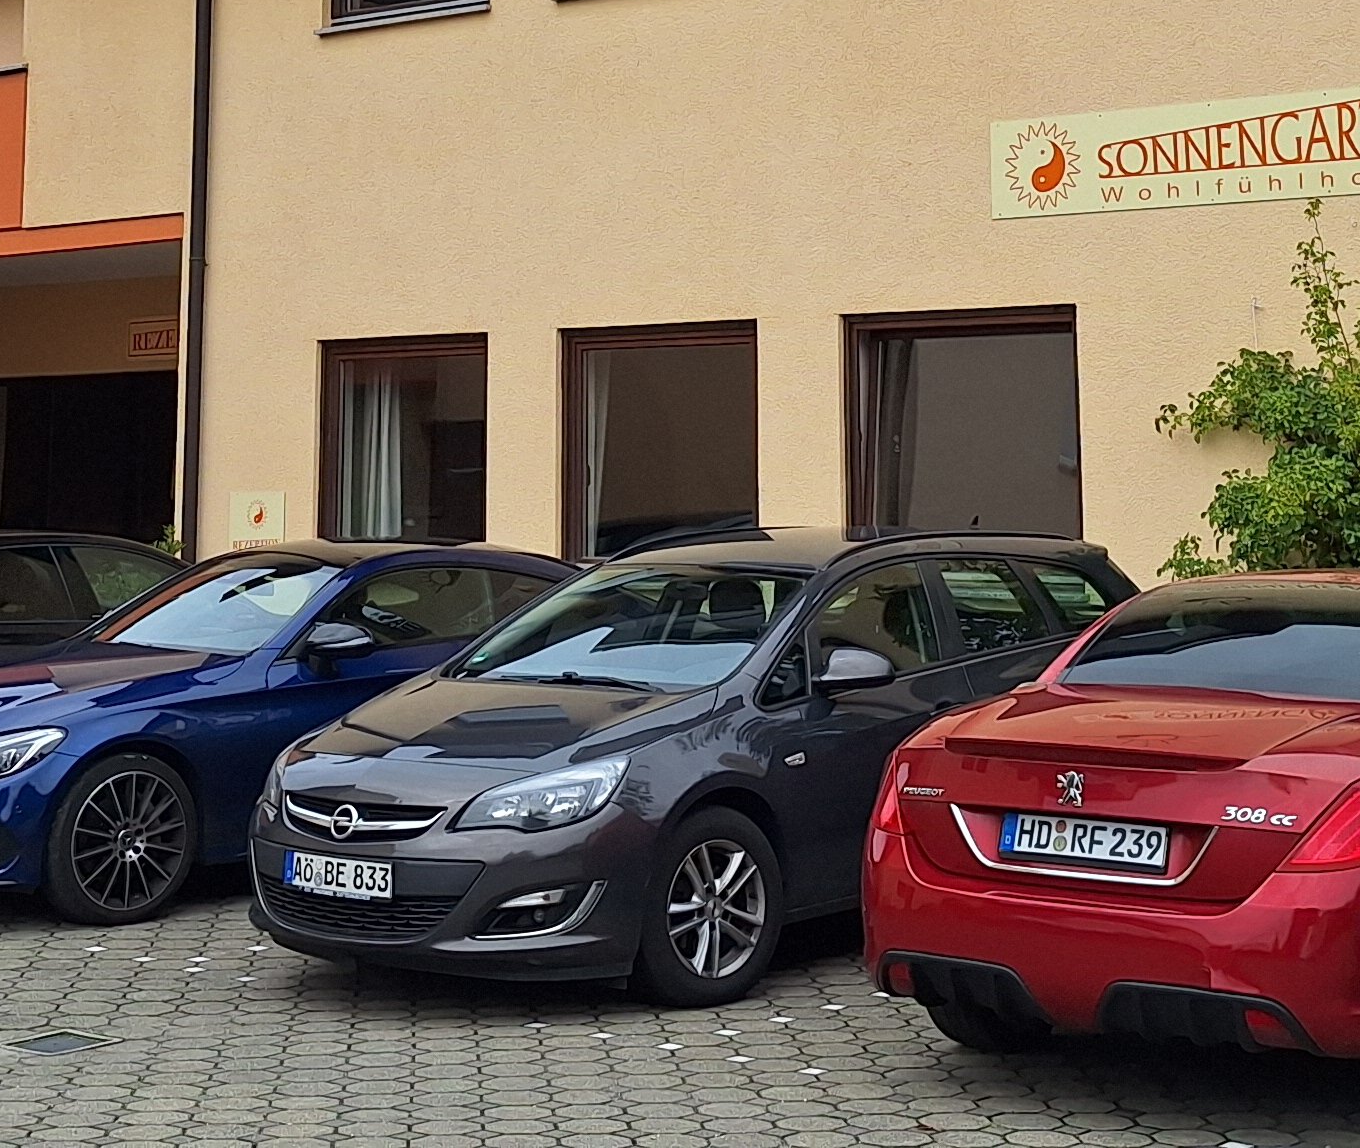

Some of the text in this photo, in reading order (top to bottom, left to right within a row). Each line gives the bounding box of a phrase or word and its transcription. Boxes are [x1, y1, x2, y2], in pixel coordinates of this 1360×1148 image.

[903, 786, 946, 797] PEUGEOT
[1220, 805, 1267, 824] 308
[1017, 818, 1053, 850] HD
[1070, 823, 1108, 855] RF
[1109, 827, 1163, 861] 239
[293, 856, 314, 883] AÖ
[324, 860, 347, 889] BE
[353, 864, 390, 893] 833
